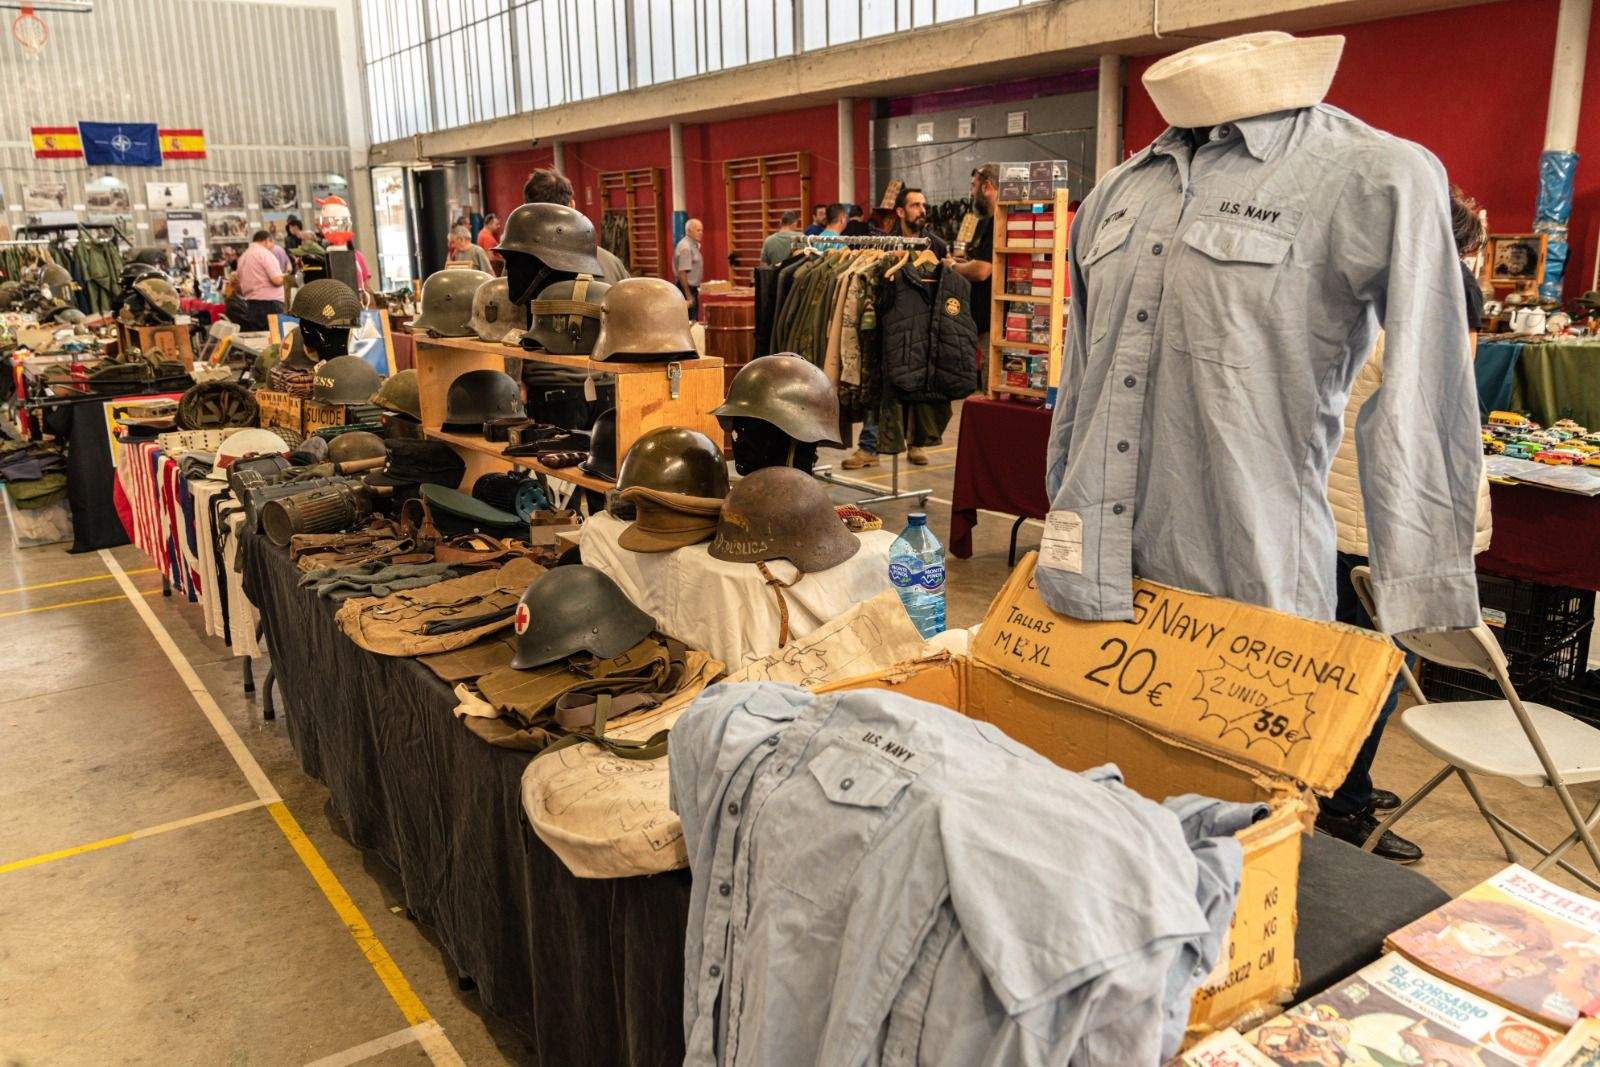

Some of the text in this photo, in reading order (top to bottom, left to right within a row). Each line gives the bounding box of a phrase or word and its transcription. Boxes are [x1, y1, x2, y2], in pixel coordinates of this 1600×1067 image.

[1219, 201, 1281, 223] U.S. NAVY
[306, 407, 341, 426] SUICIDE
[1006, 605, 1055, 633] TALLAS
[1083, 637, 1173, 707] 20€
[1229, 634, 1360, 696] ORIGINAL
[1209, 676, 1226, 695] 2
[881, 741, 916, 762] NAVY
[1264, 886, 1278, 910] KG
[1263, 916, 1277, 940] KG
[1259, 947, 1275, 971] CM
[1387, 975, 1411, 990] DE
[1410, 988, 1470, 1022] HIERRO
[1390, 963, 1408, 979] EL
[1411, 977, 1489, 1019] CORSARIO
